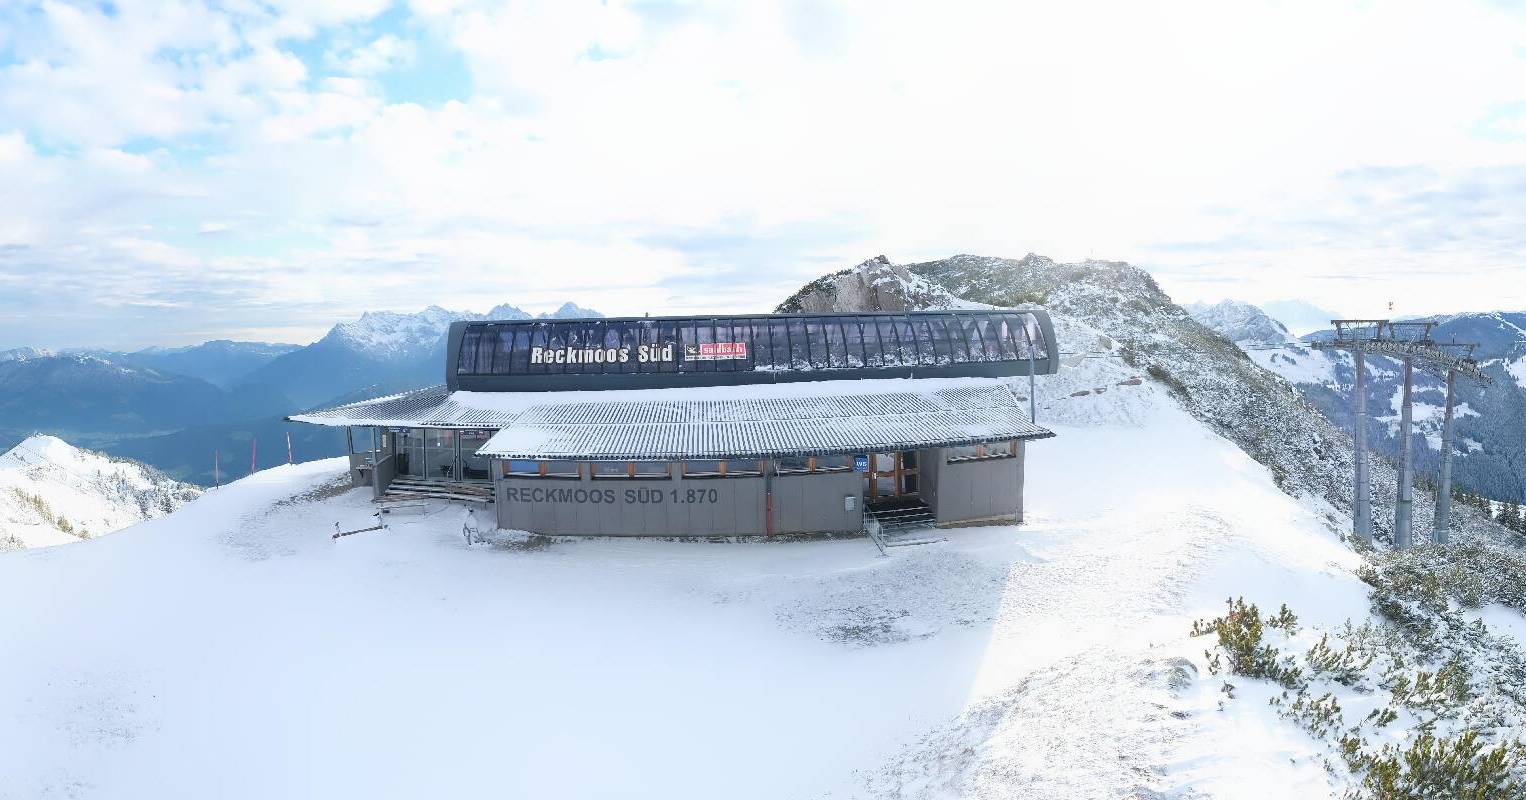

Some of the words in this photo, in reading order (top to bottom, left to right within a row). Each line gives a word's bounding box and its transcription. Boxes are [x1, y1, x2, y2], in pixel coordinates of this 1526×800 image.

[531, 346, 629, 364] Reckmoos
[637, 344, 673, 362] Süd
[506, 487, 616, 504] RECKMOOS
[624, 488, 664, 504] SÜD
[670, 489, 718, 504] 1.870
